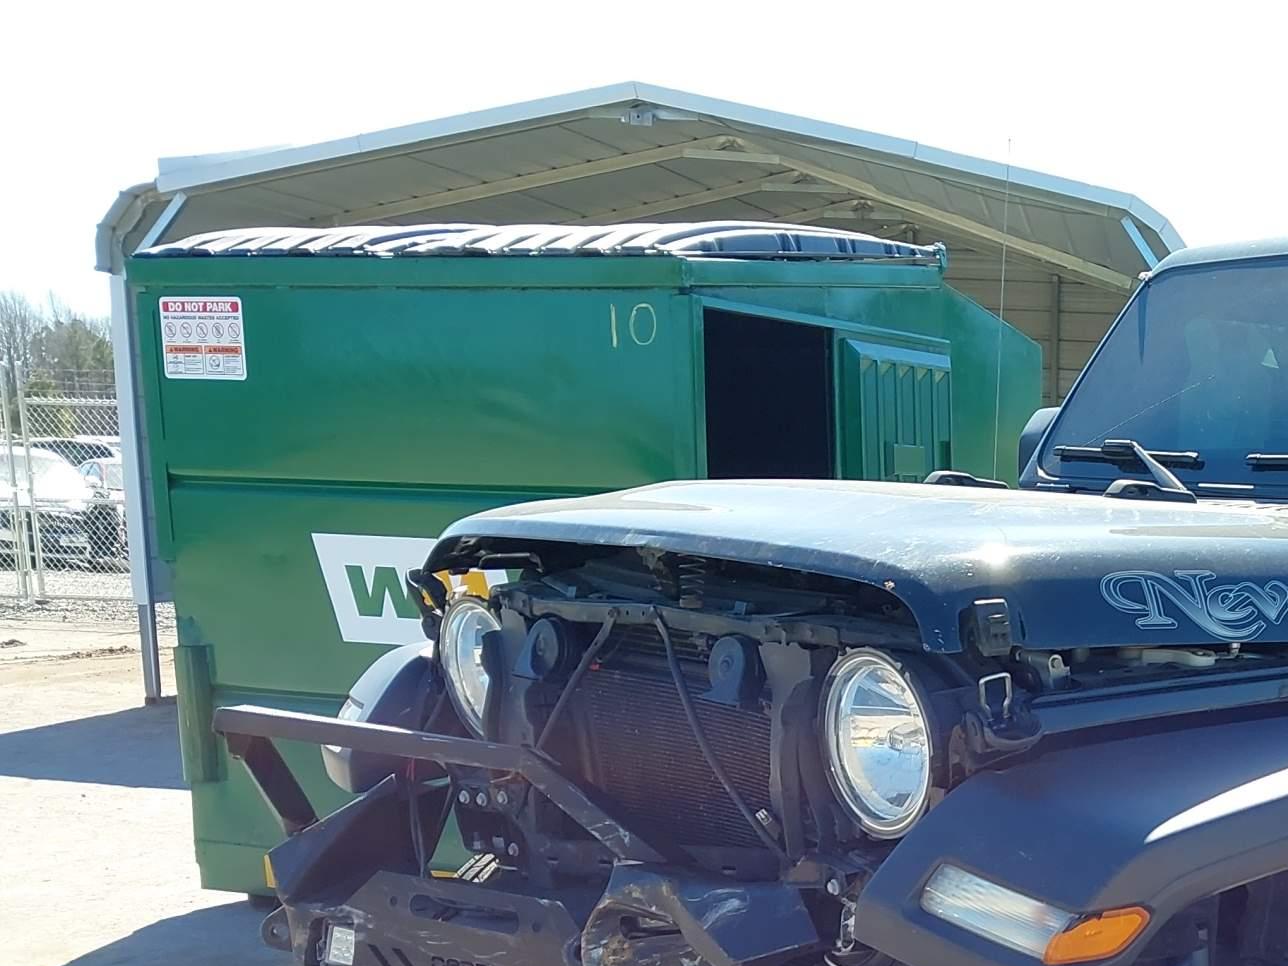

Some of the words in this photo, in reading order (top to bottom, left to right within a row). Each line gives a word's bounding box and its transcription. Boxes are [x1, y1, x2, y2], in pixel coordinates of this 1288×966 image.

[167, 302, 183, 312] DO
[184, 302, 205, 312] NOT
[206, 302, 233, 312] PARK
[610, 303, 657, 348] 10
